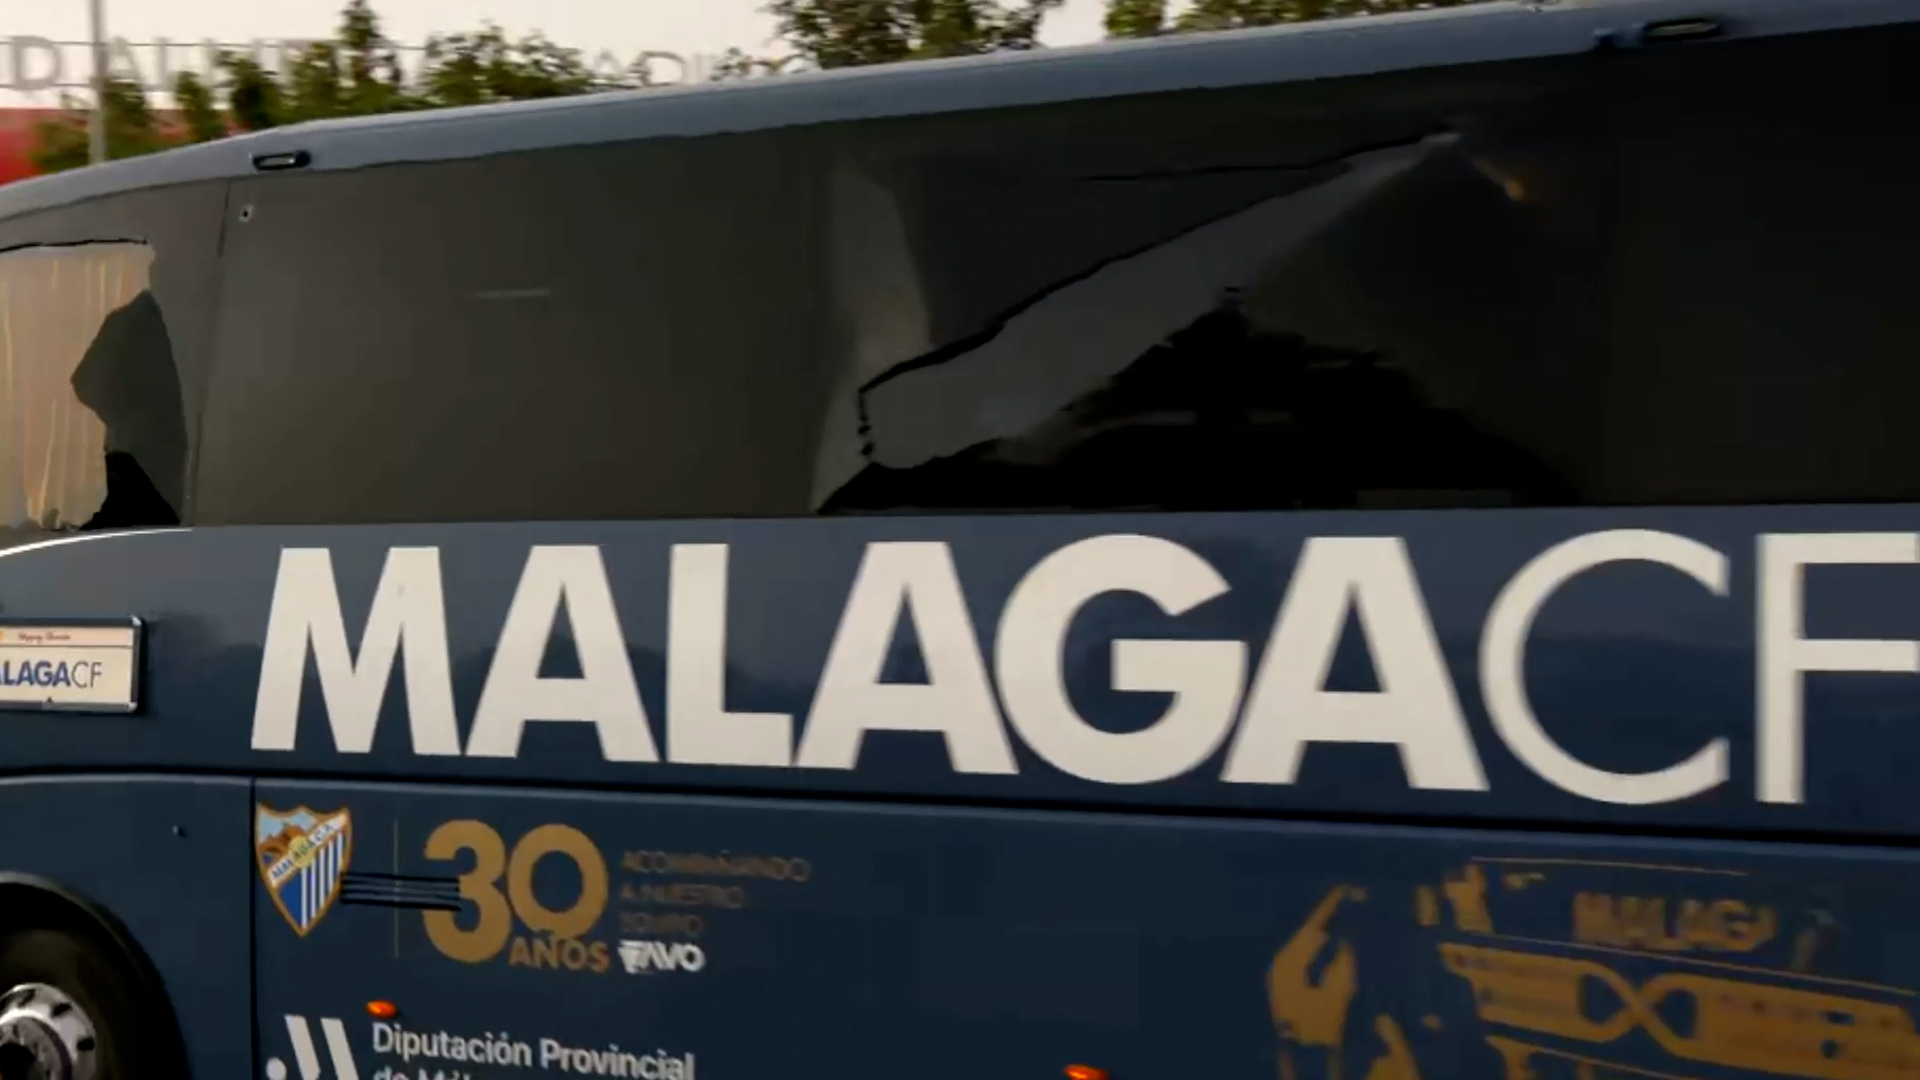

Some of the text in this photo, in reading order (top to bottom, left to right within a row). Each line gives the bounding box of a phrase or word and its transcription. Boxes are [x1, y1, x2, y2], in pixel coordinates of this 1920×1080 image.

[0, 660, 102, 688] LAGACF
[423, 819, 609, 964] 30
[508, 929, 611, 974] AÑOS
[372, 1021, 696, 1080] Diputación Provincial
